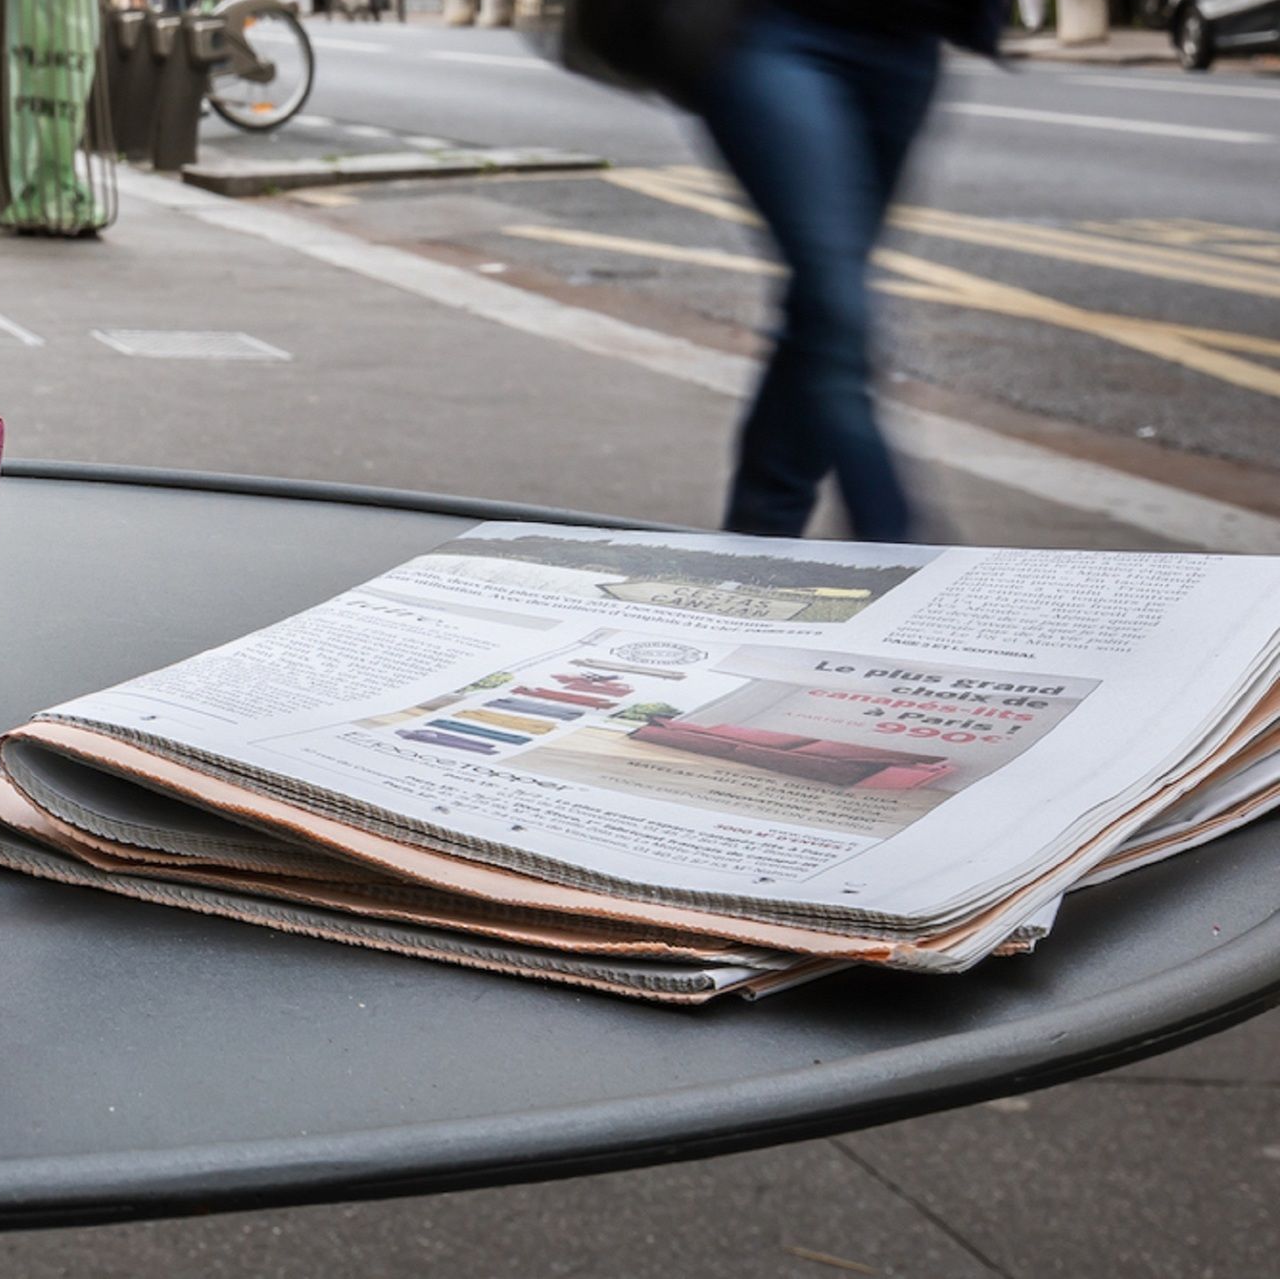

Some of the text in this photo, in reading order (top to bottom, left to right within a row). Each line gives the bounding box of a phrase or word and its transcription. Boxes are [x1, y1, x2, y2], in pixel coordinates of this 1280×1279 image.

[815, 660, 1066, 696] Le plus grand
[808, 686, 1036, 722] canapés-lits
[891, 684, 1050, 710] choix de
[863, 706, 1023, 735] à Paris !
